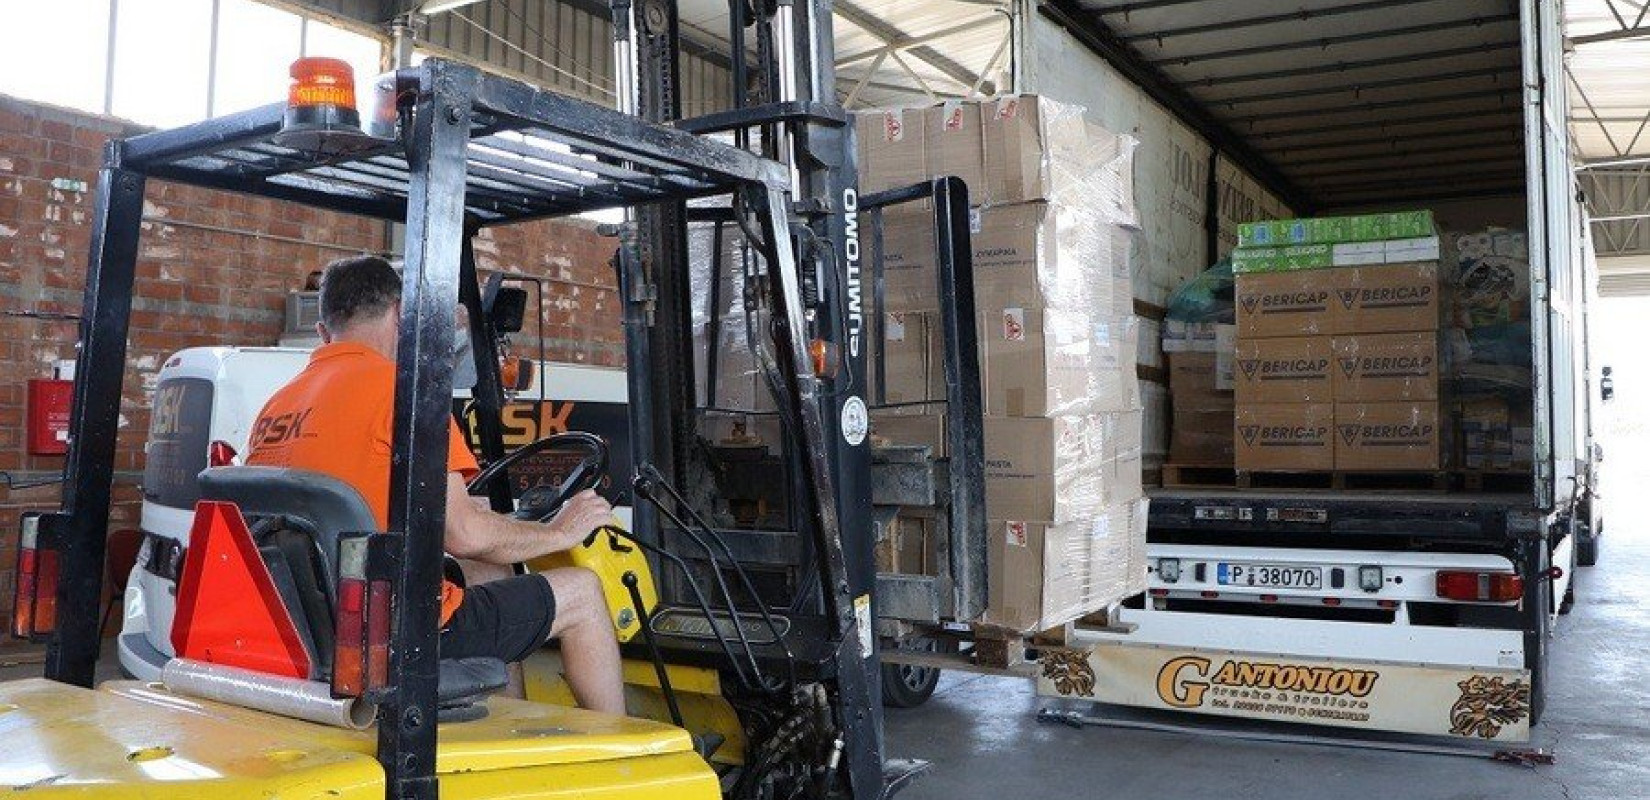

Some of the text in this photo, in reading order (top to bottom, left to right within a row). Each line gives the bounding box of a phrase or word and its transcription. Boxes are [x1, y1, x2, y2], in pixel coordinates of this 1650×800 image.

[843, 188, 862, 357] SUMITOMO
[1262, 291, 1328, 307] BERICAP
[1362, 286, 1431, 302] BERICAP
[1262, 359, 1328, 373] BERICAP
[1362, 356, 1432, 371] BERICAP
[249, 407, 312, 447] BSK
[1262, 425, 1328, 439] BERICAP
[1362, 425, 1432, 438] BERICAP
[986, 460, 1012, 468] PASTA
[1233, 566, 1315, 586] P 38070
[1293, 694, 1369, 709] trailers
